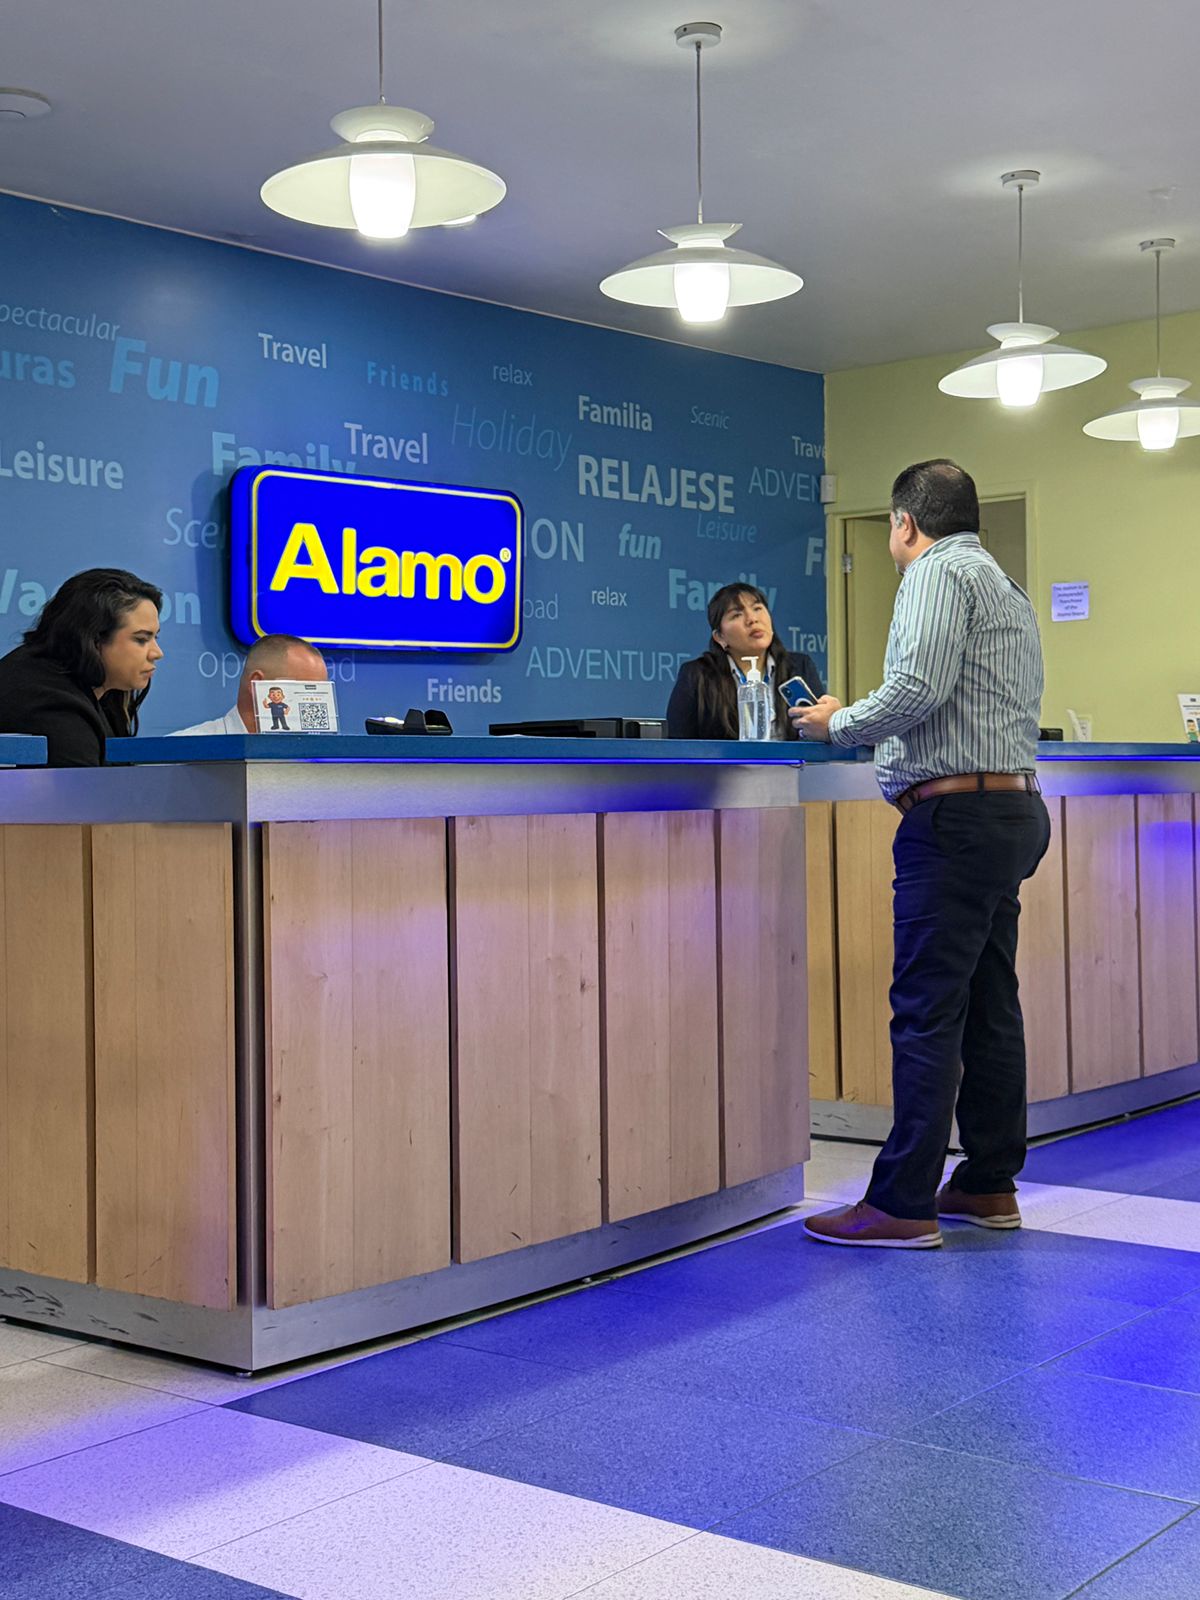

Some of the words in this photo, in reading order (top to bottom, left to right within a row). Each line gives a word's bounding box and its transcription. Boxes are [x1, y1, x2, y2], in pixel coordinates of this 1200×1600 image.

[257, 332, 328, 369] Travel
[108, 336, 220, 408] Fun
[366, 361, 449, 397] Friends
[492, 364, 533, 386] relax
[578, 395, 653, 432] Familia
[690, 405, 730, 430] Scenic
[343, 422, 429, 464] Travel
[451, 403, 573, 472] Holiday
[578, 454, 735, 514] RELAJESE
[618, 523, 662, 560] fun
[696, 514, 758, 543] Leisure
[591, 585, 628, 608] relax
[427, 676, 502, 703] Friends
